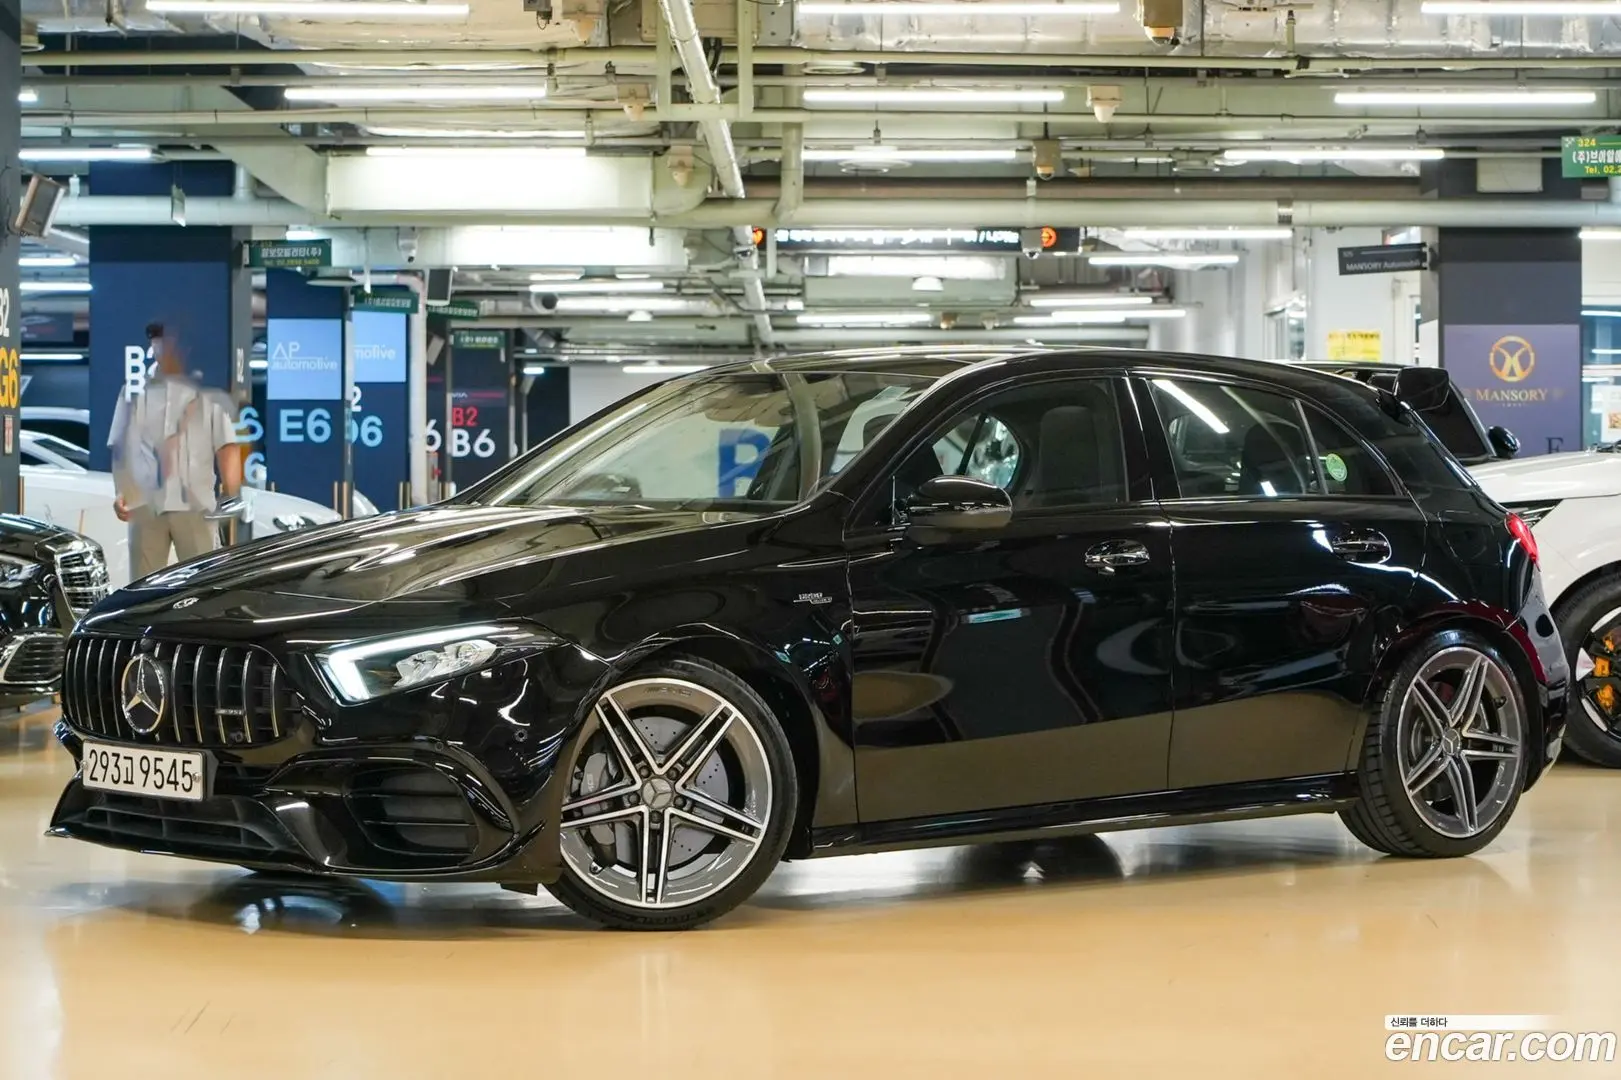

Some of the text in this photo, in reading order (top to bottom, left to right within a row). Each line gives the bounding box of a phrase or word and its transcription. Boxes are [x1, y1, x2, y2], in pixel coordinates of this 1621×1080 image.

[271, 357, 338, 370] automotive
[1476, 388, 1548, 401] MANSORY
[279, 408, 332, 443] E6
[452, 406, 478, 427] B2
[452, 429, 496, 458] B6
[89, 749, 193, 792] 293고 9545
